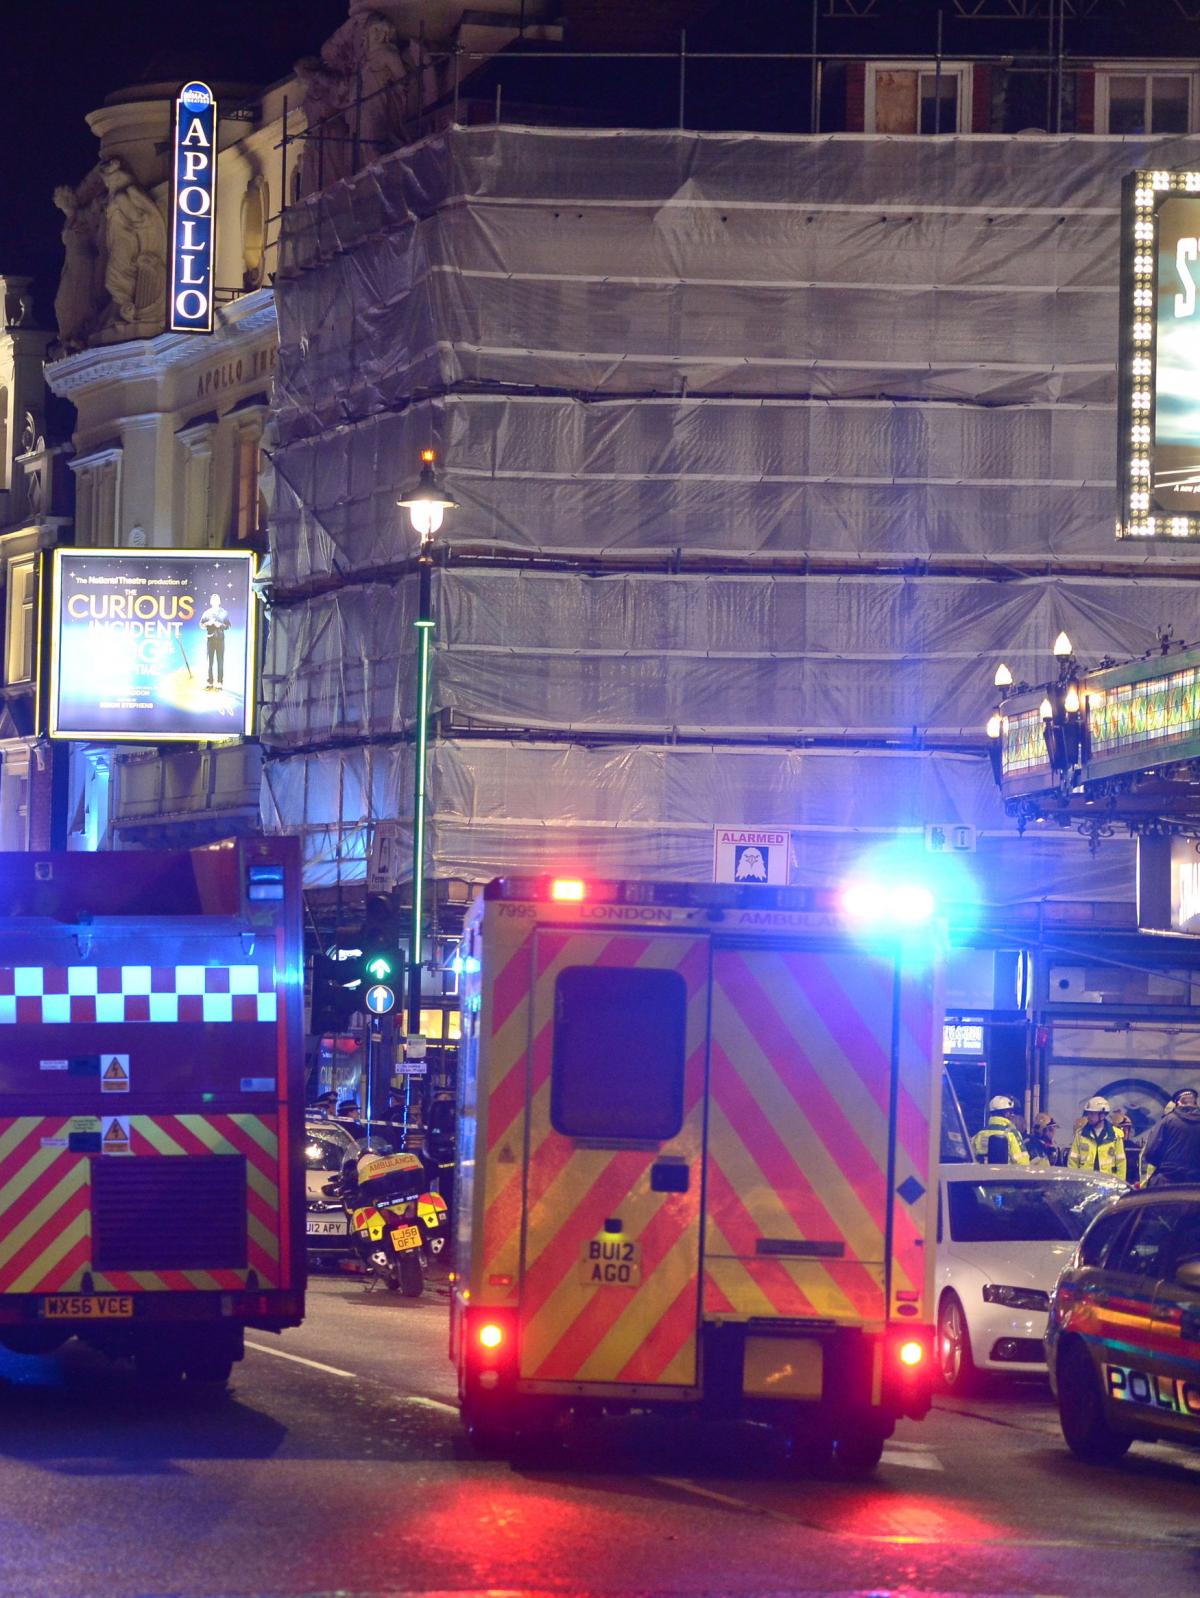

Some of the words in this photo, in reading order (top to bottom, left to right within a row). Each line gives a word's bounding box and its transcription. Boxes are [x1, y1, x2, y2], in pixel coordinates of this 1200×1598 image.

[175, 117, 211, 319] APOLLO
[1174, 237, 1200, 318] S
[197, 359, 242, 397] APOLLO
[147, 578, 180, 586] production
[125, 588, 138, 596] THE
[67, 593, 196, 620] CURIOUS
[88, 619, 184, 640] INCIDENT
[721, 832, 785, 844] ALARMED
[497, 903, 537, 918] 7995
[580, 905, 673, 921] LONDON
[738, 911, 846, 929] AMBULAN
[369, 1155, 414, 1172] AMBULANCE
[323, 1223, 341, 1233] APY
[393, 1228, 418, 1241] LJ58
[589, 1241, 634, 1262] BU12
[47, 1298, 92, 1315] WX56
[97, 1298, 130, 1314] VCE
